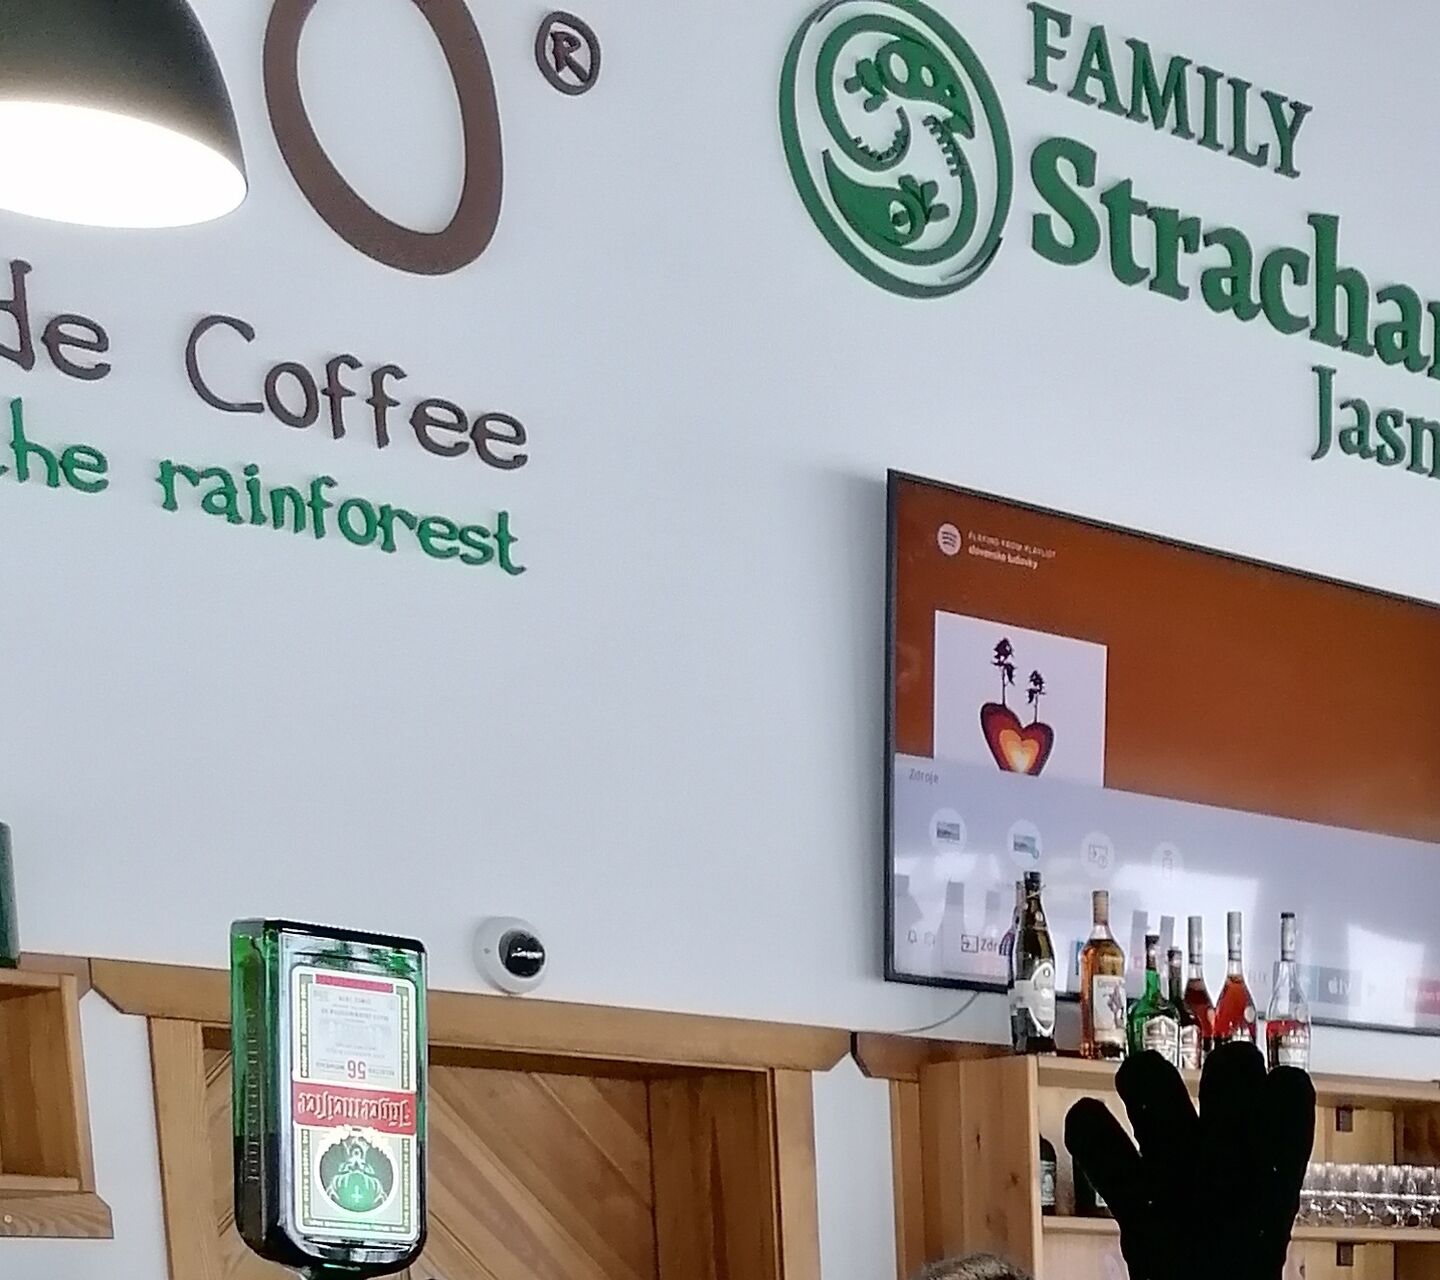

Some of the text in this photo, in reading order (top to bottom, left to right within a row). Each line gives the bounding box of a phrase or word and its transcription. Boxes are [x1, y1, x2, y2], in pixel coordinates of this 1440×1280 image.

[1026, 1, 1313, 180] FAMILY
[185, 314, 529, 470] Coffee
[155, 457, 527, 576] rainforest
[347, 1059, 366, 1080] 56
